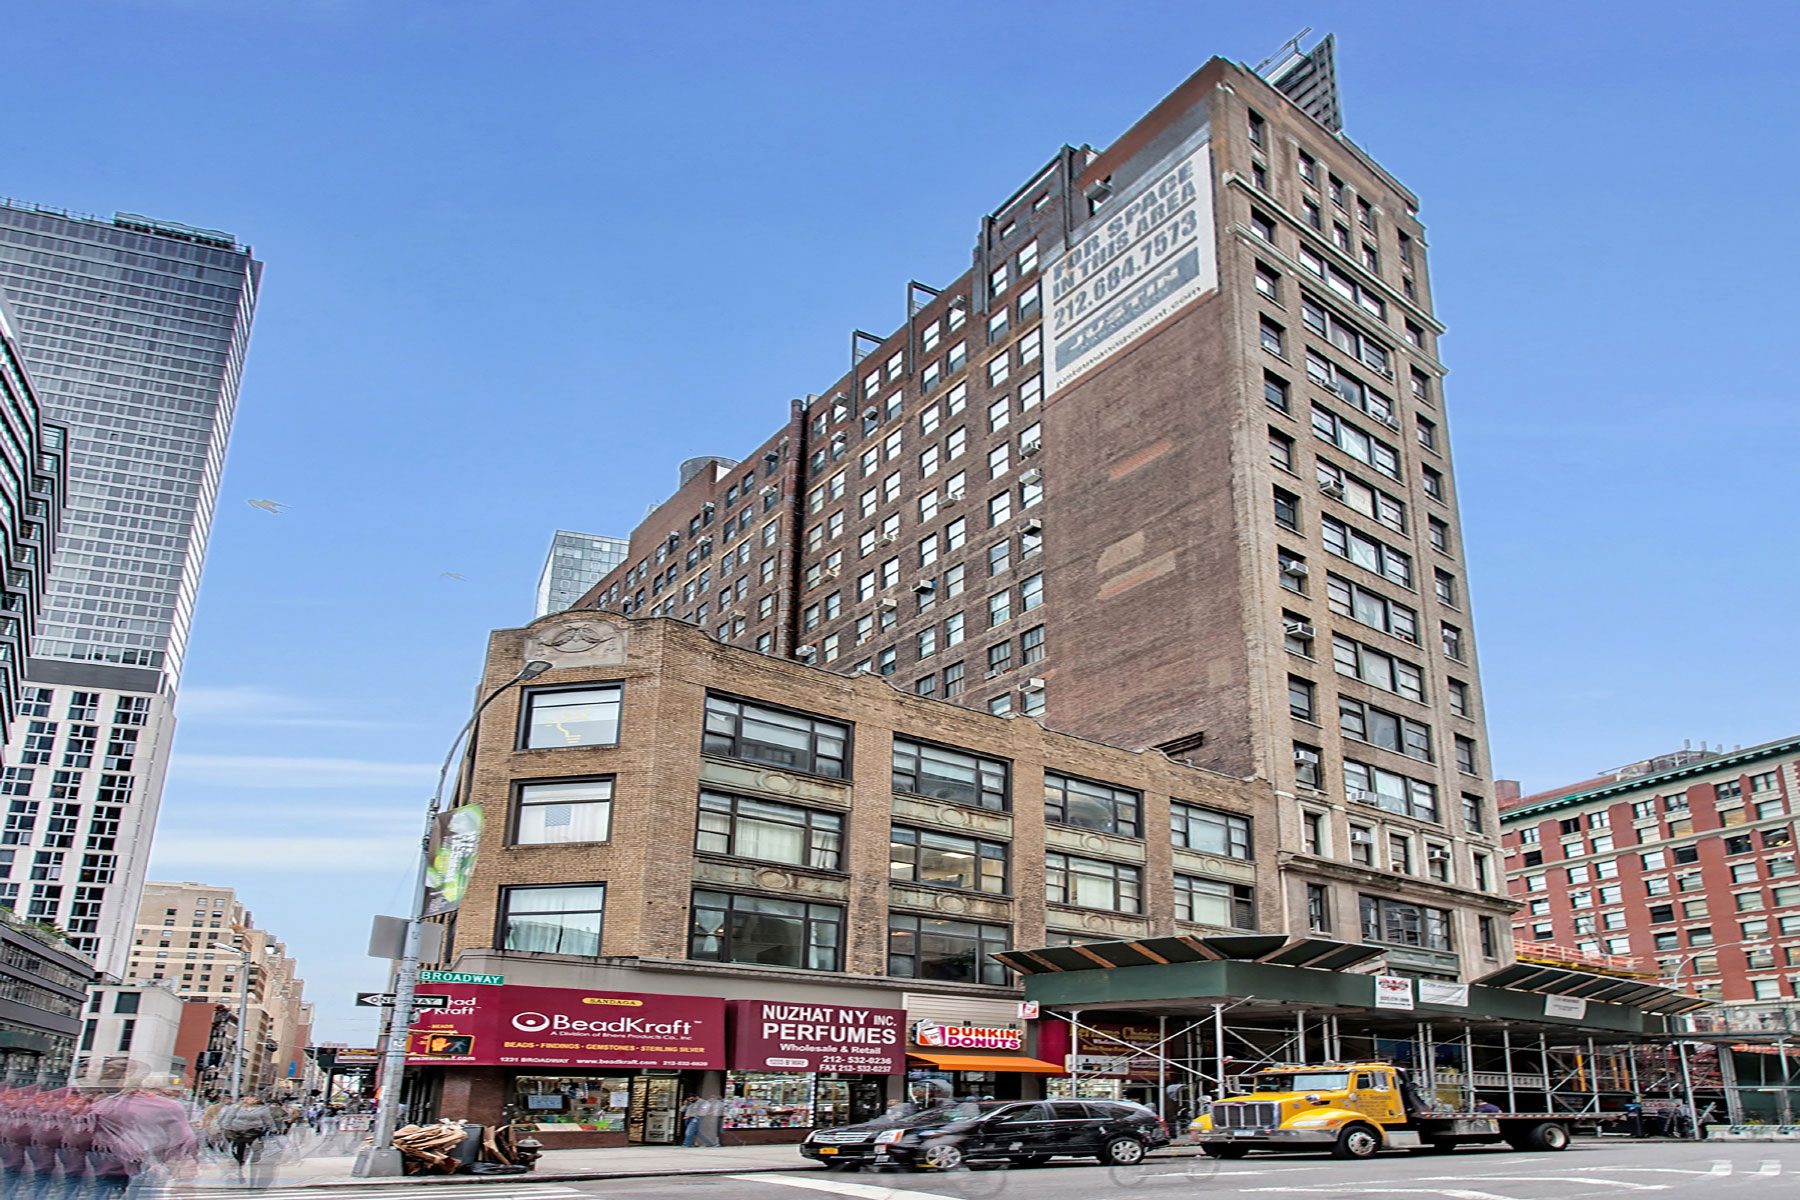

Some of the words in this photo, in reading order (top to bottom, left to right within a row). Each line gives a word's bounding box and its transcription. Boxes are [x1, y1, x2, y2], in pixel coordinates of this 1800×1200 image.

[1053, 233, 1100, 282] FOR
[1107, 160, 1193, 240] SPACE
[1052, 270, 1075, 300] IN
[1079, 228, 1129, 279] THIS
[1135, 179, 1197, 238] AREA
[1054, 207, 1197, 331] 212.684.7573
[1069, 267, 1179, 350] JUSTIN
[421, 971, 500, 984] BROADWAY
[553, 1014, 692, 1035] BeadKraft
[763, 1004, 834, 1023] NUZHAT
[839, 1009, 869, 1025] NY
[873, 1015, 897, 1026] INC.
[763, 1022, 897, 1045] PERFUMES
[948, 1027, 1023, 1039] DUNKIN'
[948, 1037, 1021, 1049] DONUTS
[780, 1043, 838, 1053] Wholesale
[851, 1046, 882, 1054] Retail
